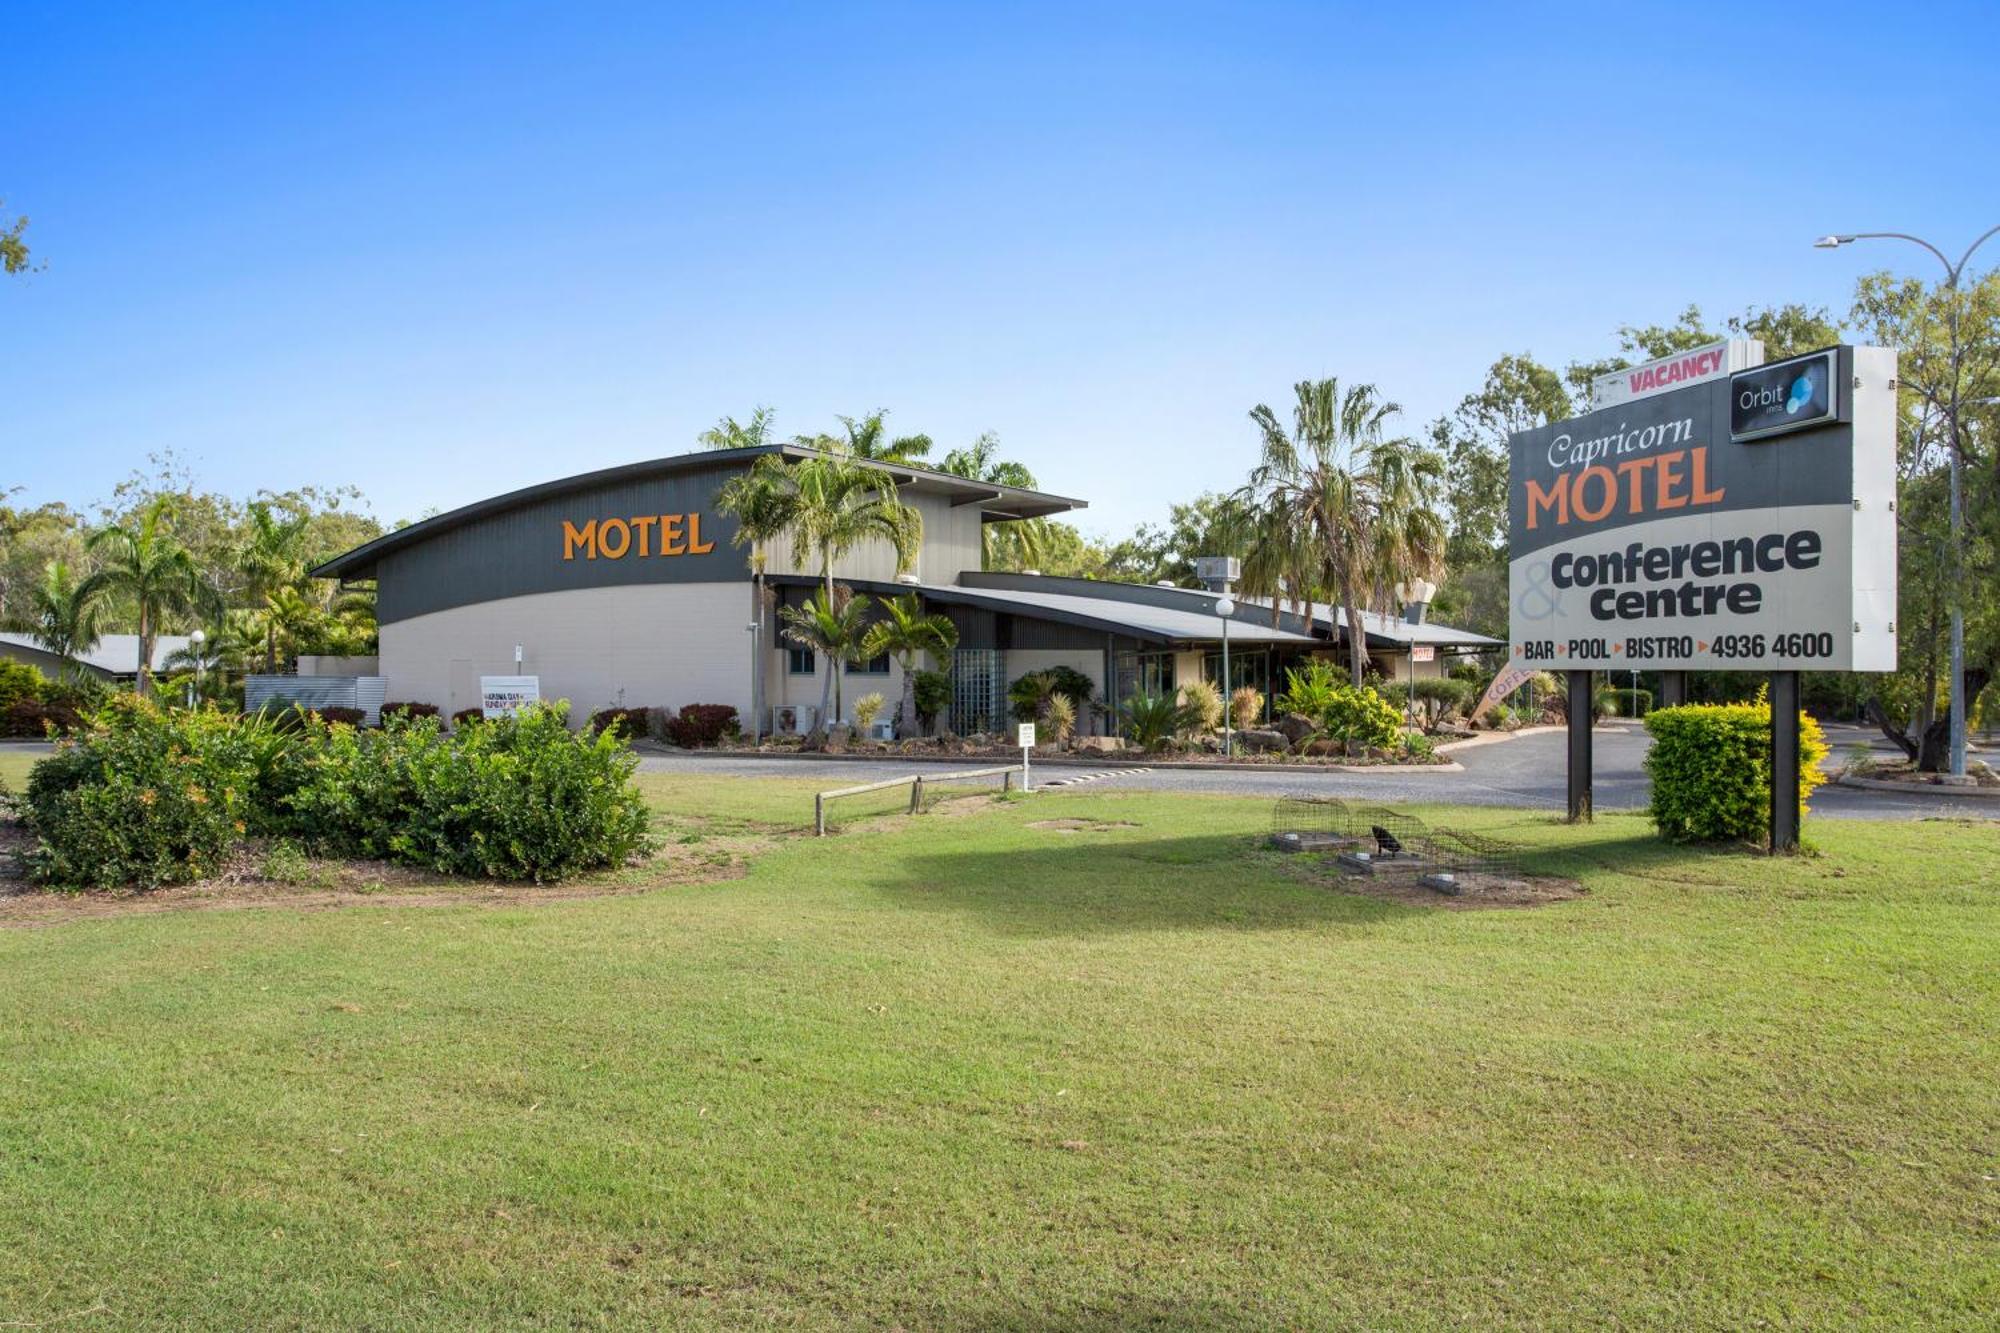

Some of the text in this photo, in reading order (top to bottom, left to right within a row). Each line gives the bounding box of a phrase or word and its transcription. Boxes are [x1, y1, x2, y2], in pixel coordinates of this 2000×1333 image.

[1630, 349, 1724, 393] VACANCY
[1740, 385, 1784, 410] Orbit
[1547, 418, 1693, 468] Capricorn
[1525, 447, 1726, 529] MOTEL
[563, 512, 715, 560] MOTEL
[1524, 632, 1833, 660] BAR POOL BISTRO 4936 4600
